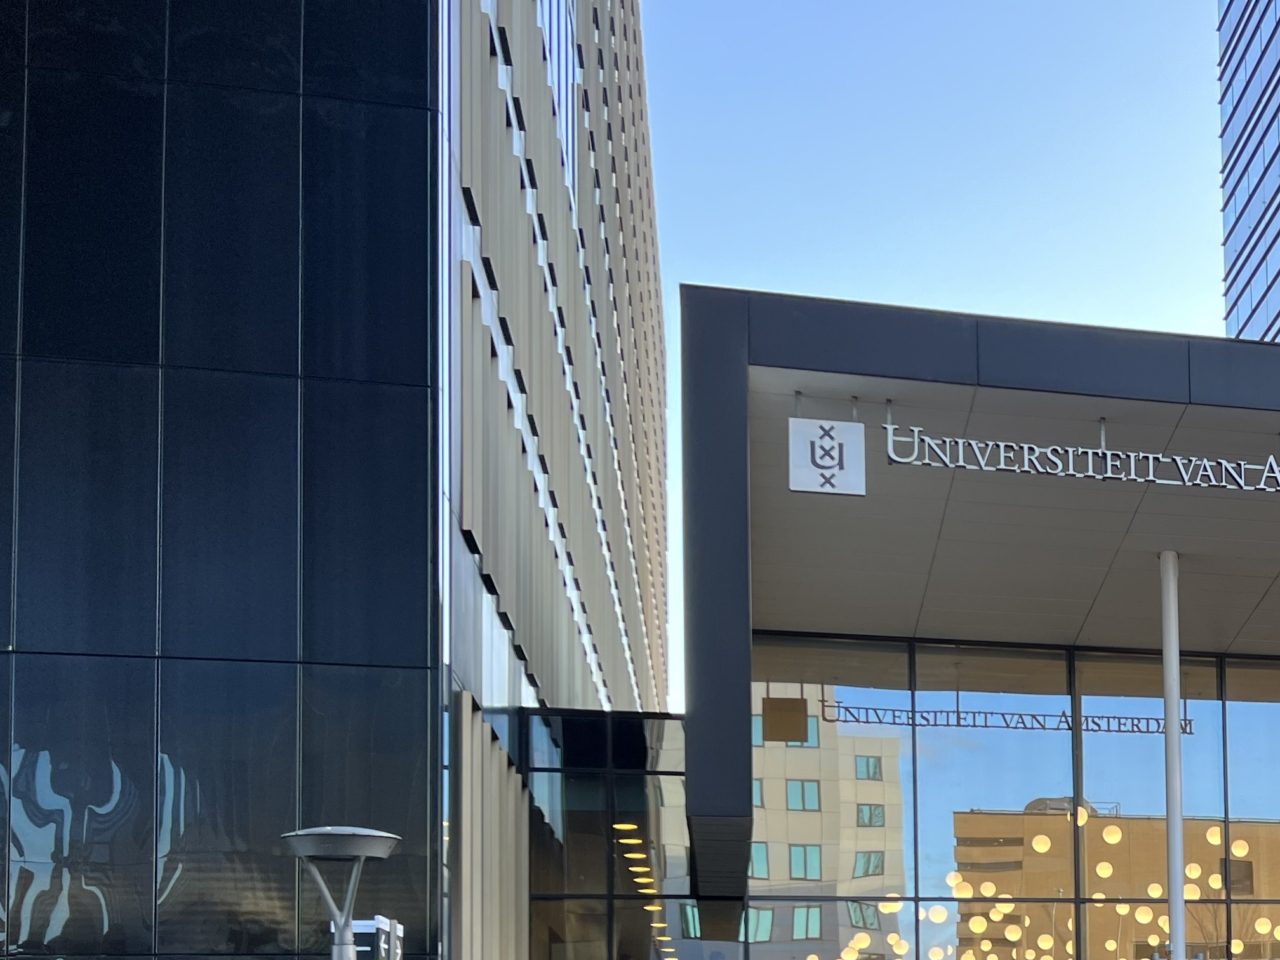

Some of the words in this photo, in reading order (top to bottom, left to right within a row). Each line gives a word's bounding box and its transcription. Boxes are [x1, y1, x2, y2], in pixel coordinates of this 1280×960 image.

[882, 423, 1163, 482] UNIVERSITEIT
[1172, 455, 1248, 489] VAN
[1001, 713, 1047, 730] VAN
